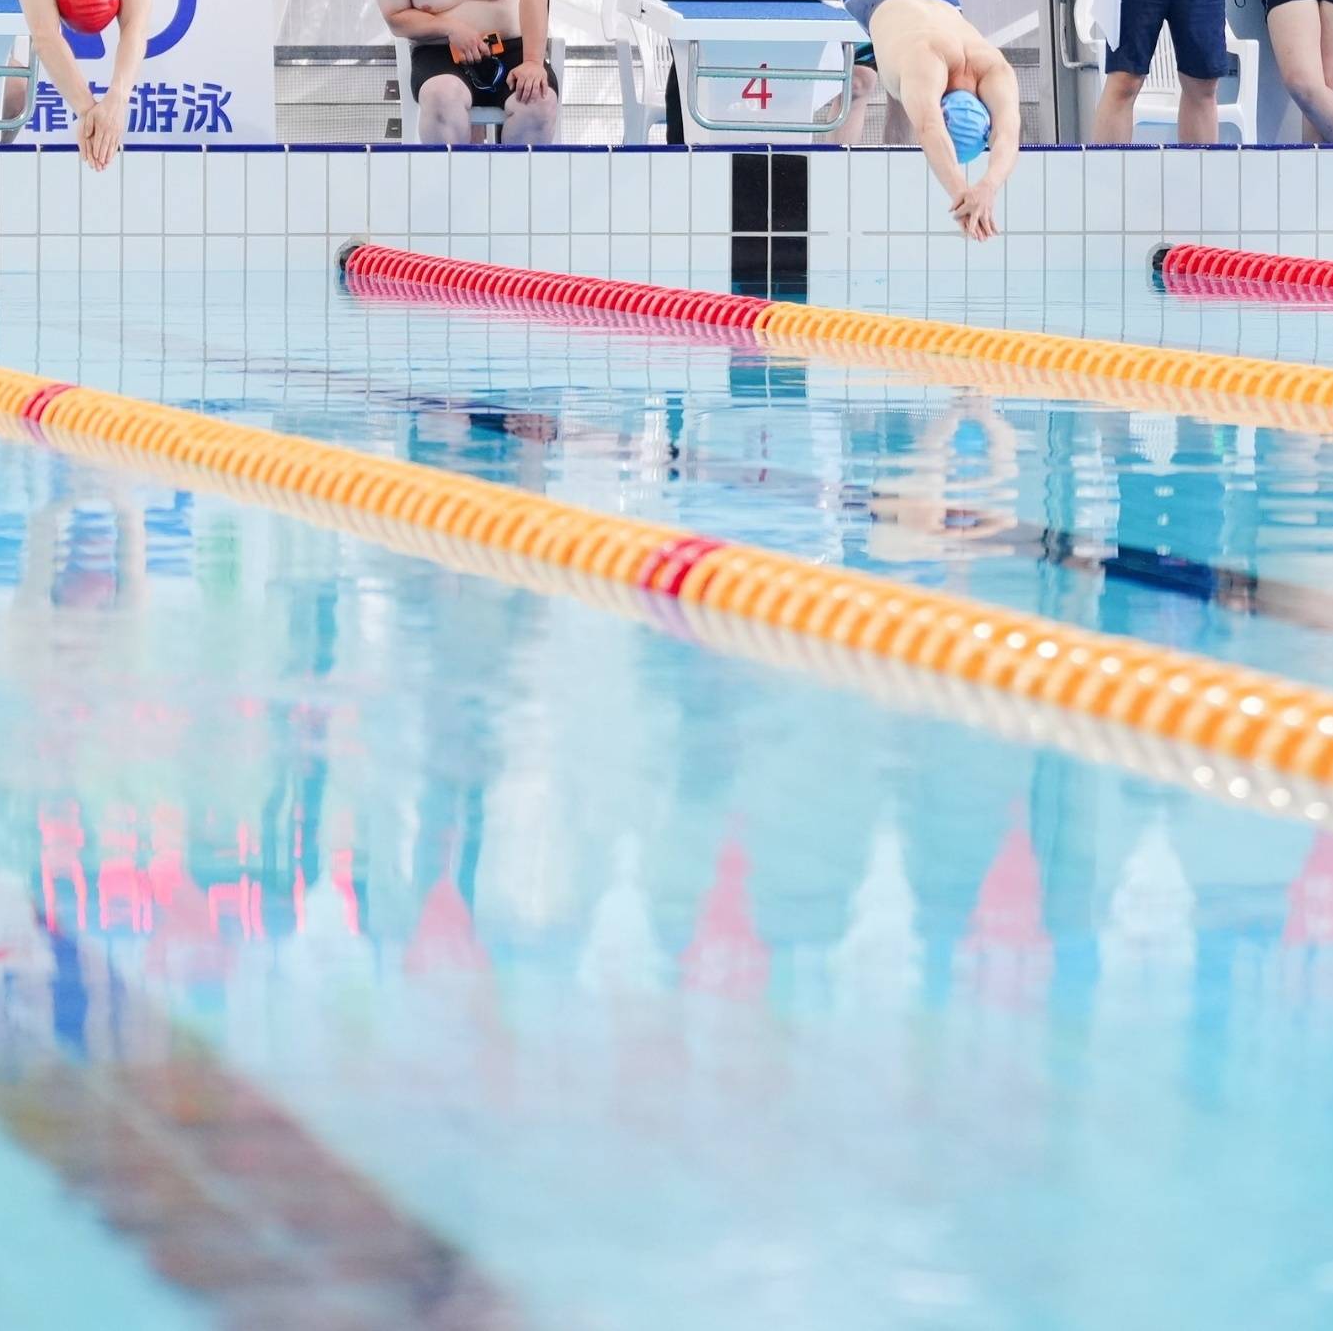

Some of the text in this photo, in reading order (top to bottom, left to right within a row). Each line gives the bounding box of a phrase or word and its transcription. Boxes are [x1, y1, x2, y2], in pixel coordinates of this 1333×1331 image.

[25, 80, 233, 133] 靠游泳
[741, 63, 773, 110] 4
